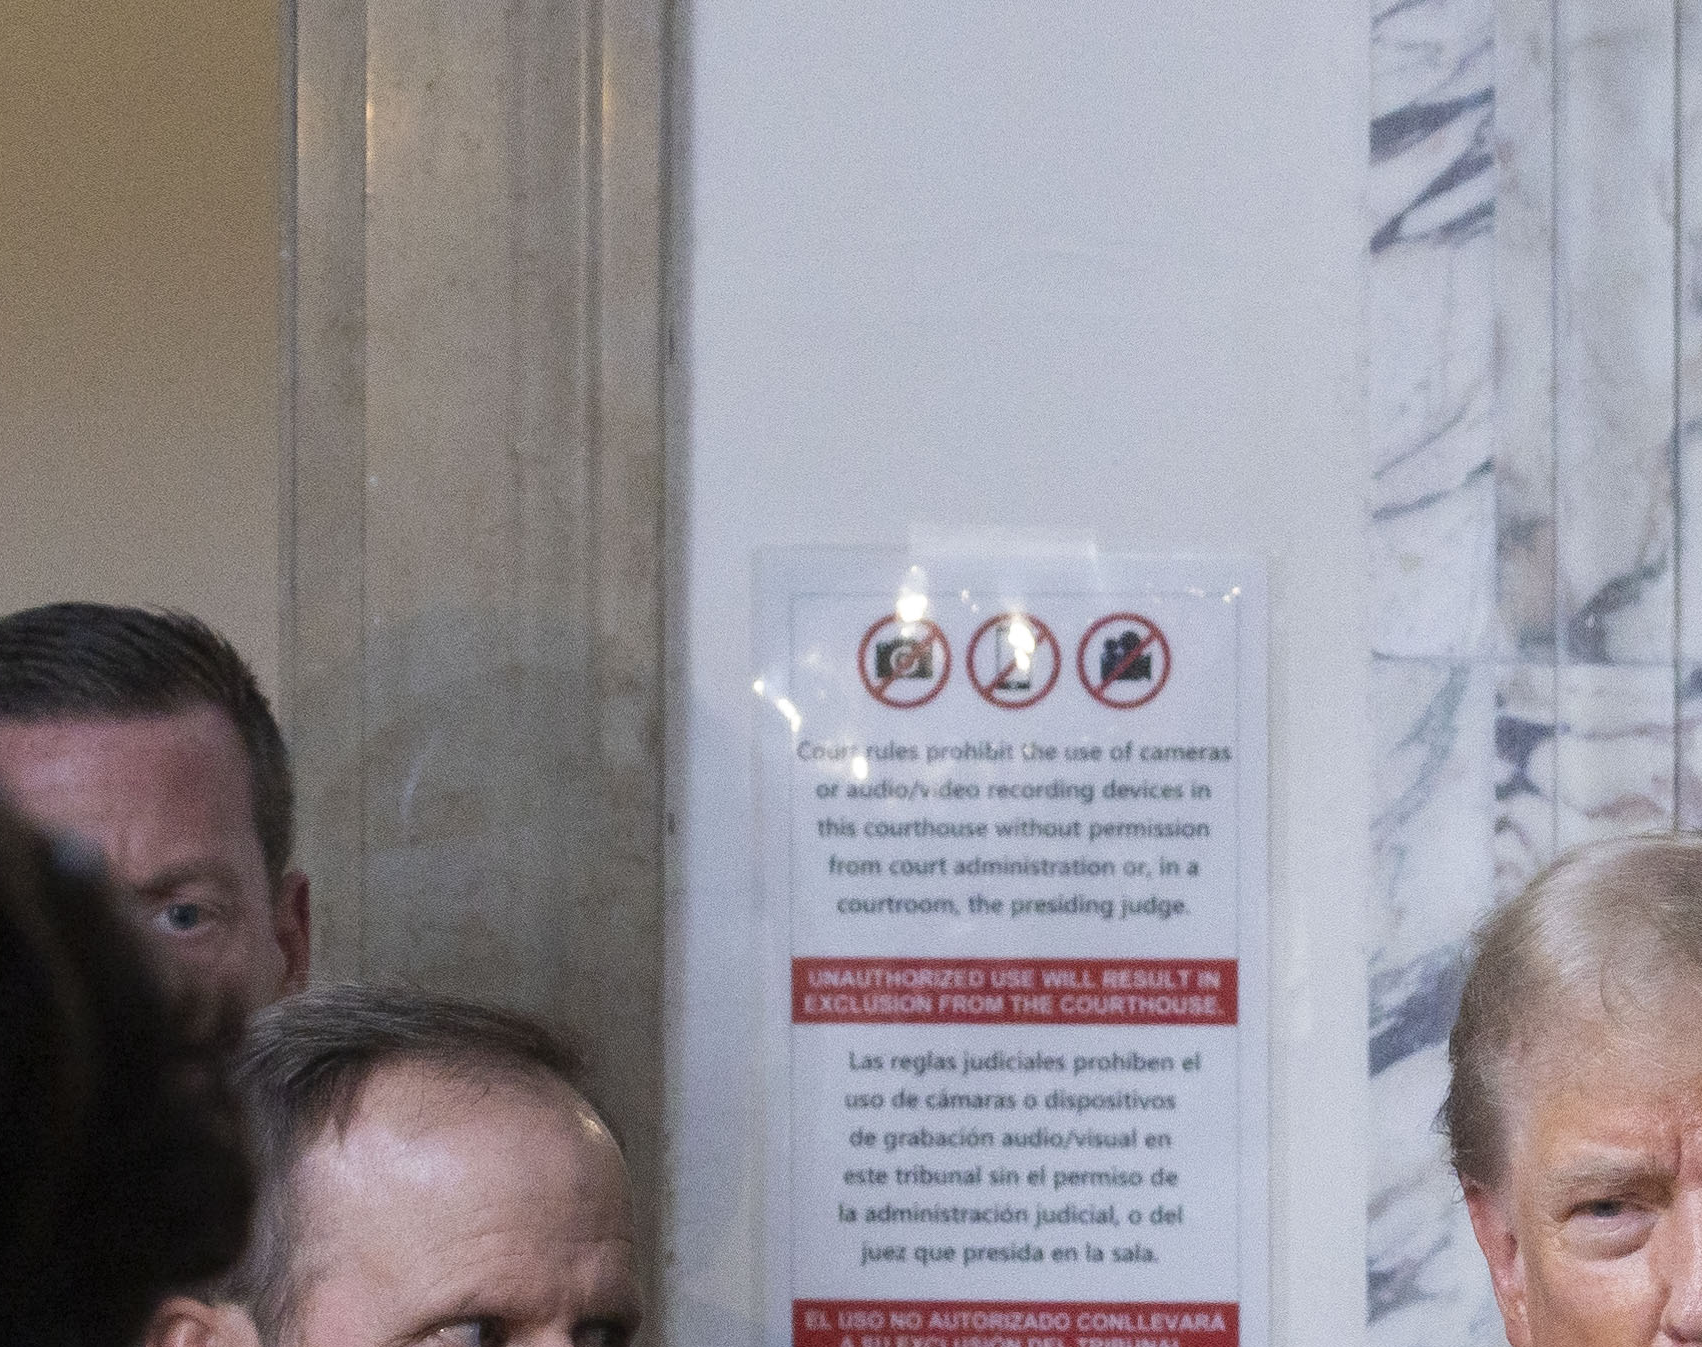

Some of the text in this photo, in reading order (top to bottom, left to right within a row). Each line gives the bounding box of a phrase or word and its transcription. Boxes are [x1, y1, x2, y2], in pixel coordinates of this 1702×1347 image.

[797, 738, 858, 762] Cour
[865, 738, 918, 762] rules
[1065, 745, 1102, 762] use
[1109, 738, 1134, 762] of
[1139, 745, 1233, 762] cameras
[816, 777, 1213, 806] or audio/vdeo recording devices in
[817, 816, 1211, 844] this courthouse without permission
[828, 854, 882, 878] from
[888, 854, 947, 878] court
[953, 854, 1116, 878] administration
[1159, 854, 1180, 878] in
[1186, 861, 1200, 878] a
[968, 893, 1004, 916] the
[1010, 893, 1115, 921] presiding
[807, 969, 1221, 988] UNAUTHORIZED USE WILL RESULT IN
[803, 995, 934, 1015] EXCLUSION
[938, 995, 1004, 1015] FROM
[1010, 995, 1053, 1015] THE
[848, 1050, 885, 1072] Las
[889, 1050, 958, 1077] reglas
[961, 1050, 1067, 1077] judiciales
[1181, 1050, 1201, 1072] el
[844, 1088, 1176, 1116] uso de cámaras o dispositivos
[849, 1126, 1171, 1154] de grabación audio/visual en
[842, 1165, 1178, 1193] este tribunal sin el permiso de
[837, 1203, 859, 1225] la
[863, 1203, 1029, 1225] administración
[1127, 1209, 1143, 1225] o
[1149, 1203, 1183, 1225] del
[860, 1242, 907, 1269] juez
[913, 1248, 956, 1269] que
[962, 1242, 1045, 1269] presida
[1051, 1248, 1078, 1264] en
[1086, 1242, 1105, 1264] la
[805, 1311, 830, 1331] EL
[838, 1311, 885, 1331] USO
[890, 1311, 923, 1331] NO
[928, 1311, 1072, 1331] AUTORIZADO
